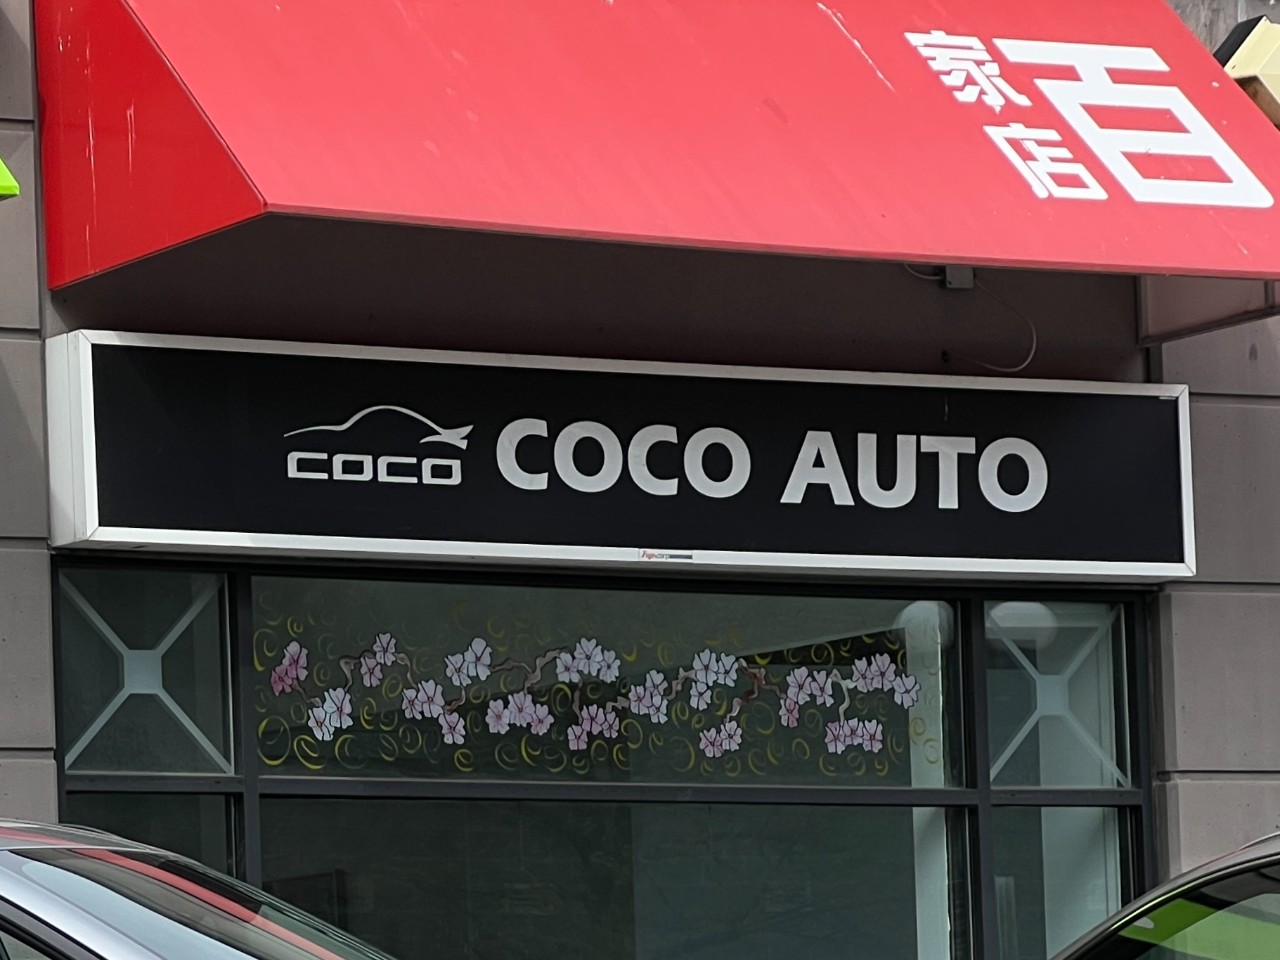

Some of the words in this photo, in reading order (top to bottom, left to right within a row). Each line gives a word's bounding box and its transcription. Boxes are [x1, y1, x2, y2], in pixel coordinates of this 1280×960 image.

[287, 451, 462, 486] COCO
[496, 418, 752, 498] COCO
[779, 430, 1048, 513] AUTO
